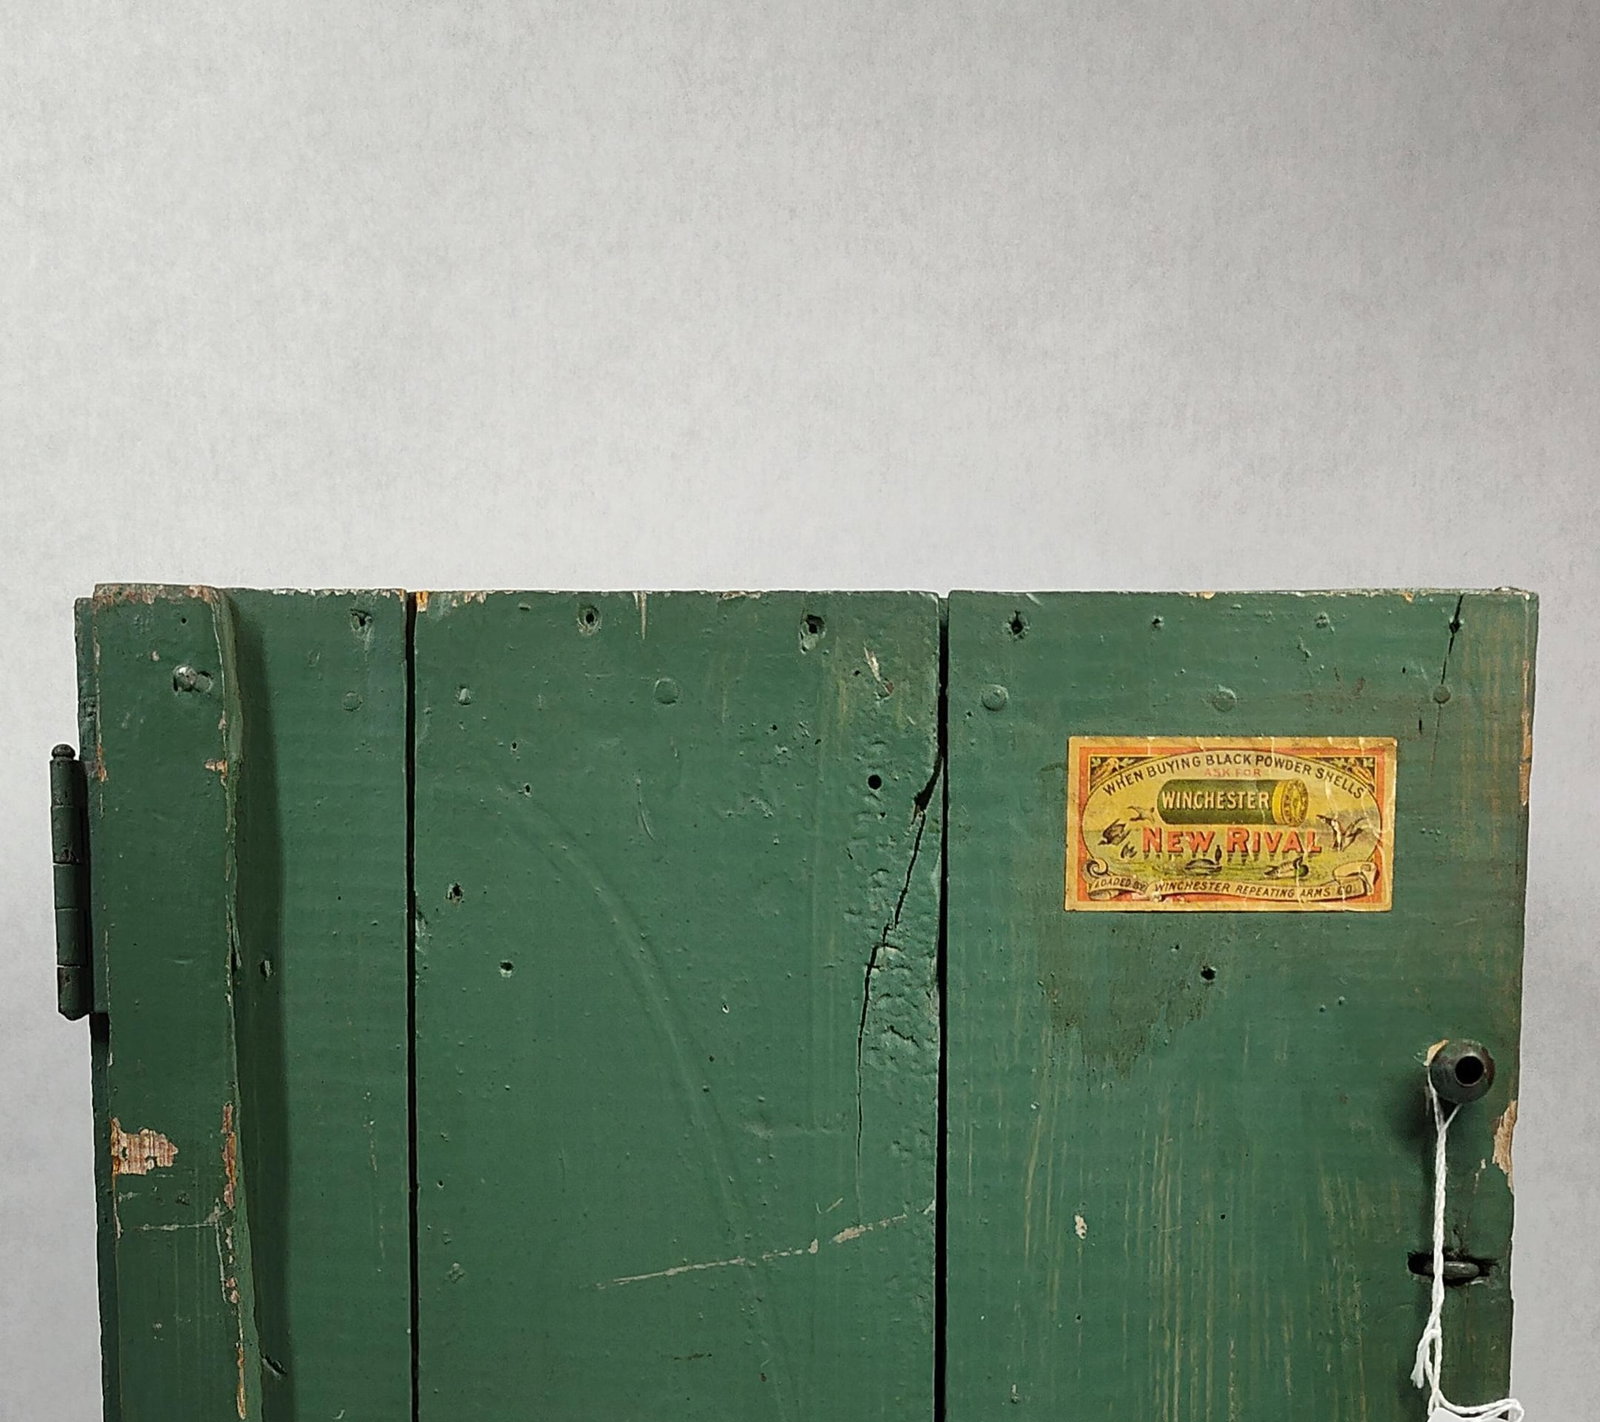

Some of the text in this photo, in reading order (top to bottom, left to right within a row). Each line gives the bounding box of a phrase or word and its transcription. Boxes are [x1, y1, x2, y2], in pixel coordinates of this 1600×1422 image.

[1103, 753, 1363, 799] WHEN BUYING BLACK POWDER SHELLS
[1205, 768, 1262, 778] ASK FOR
[1162, 790, 1270, 812] WINCHESTER
[1143, 827, 1323, 854] NEW RIVAL
[1095, 876, 1131, 889] LOADED
[1155, 881, 1230, 894] WINCHESTER
[1236, 884, 1294, 898] REPEATING
[1299, 888, 1331, 898] ARMS
